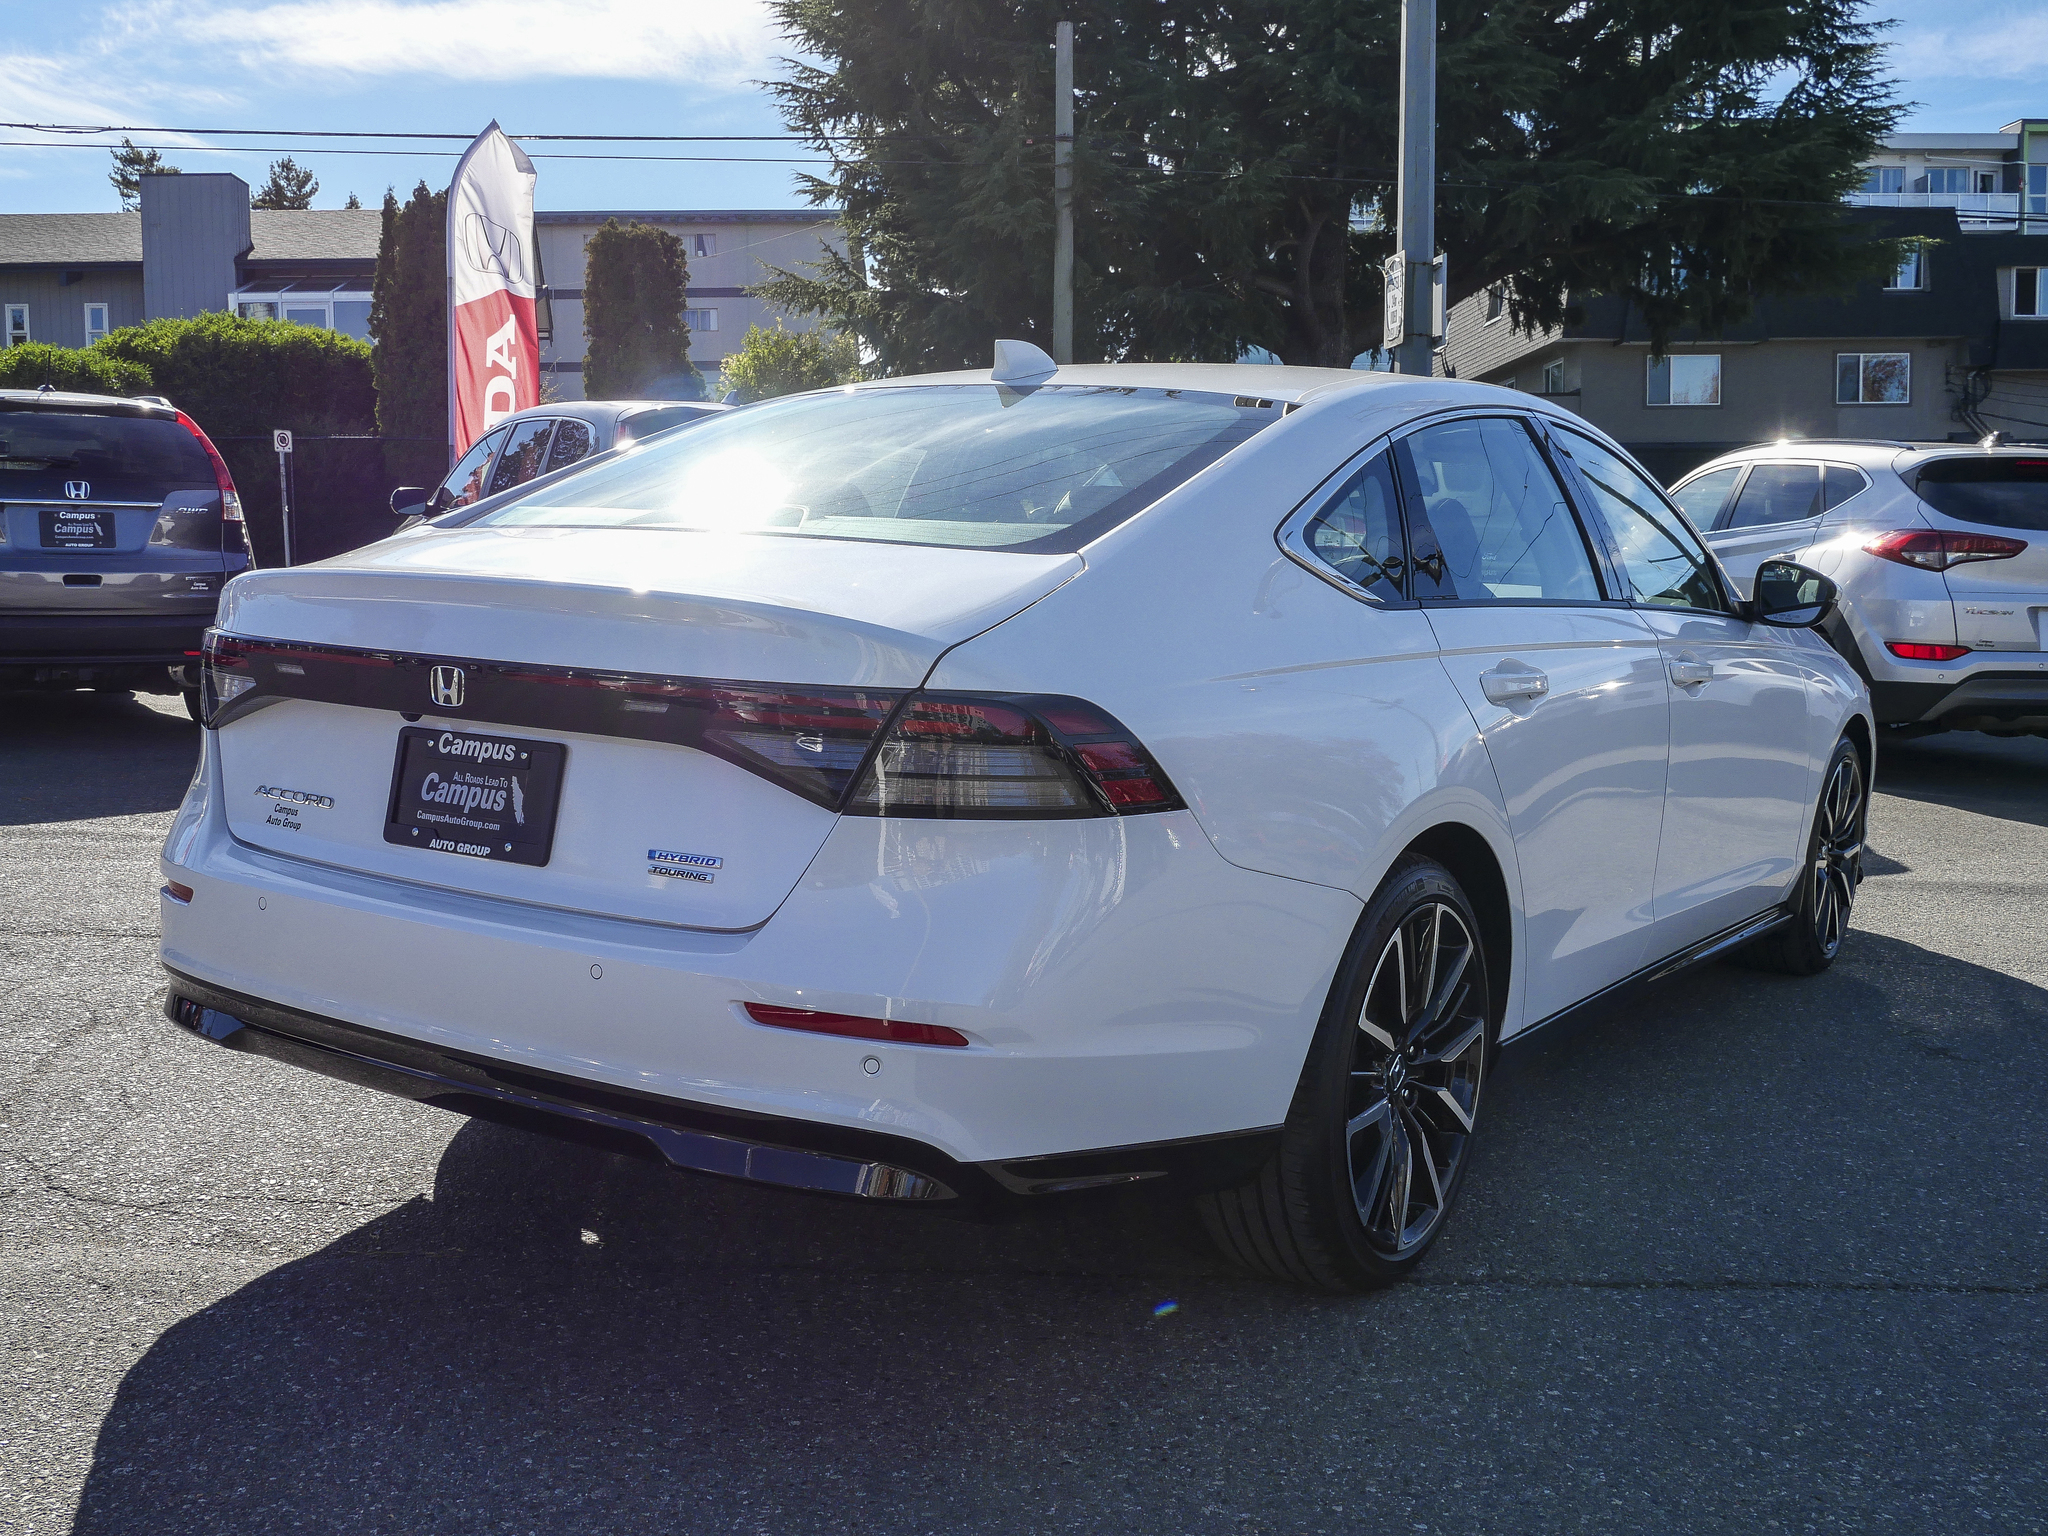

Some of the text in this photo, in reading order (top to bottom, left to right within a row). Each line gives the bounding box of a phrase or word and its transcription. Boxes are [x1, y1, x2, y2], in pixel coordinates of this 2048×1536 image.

[59, 511, 96, 521] Campus
[54, 523, 94, 535] Campus
[438, 732, 517, 763] Campus
[253, 784, 335, 810] ACCORD
[421, 772, 507, 814] Campus
[274, 803, 299, 817] Campus
[265, 814, 302, 831] Auto Group
[416, 809, 501, 832] CampusAutoGroup.com
[429, 838, 491, 857] AUTO GROUP
[657, 852, 717, 866] HYBRID
[651, 866, 708, 881] TOURING
